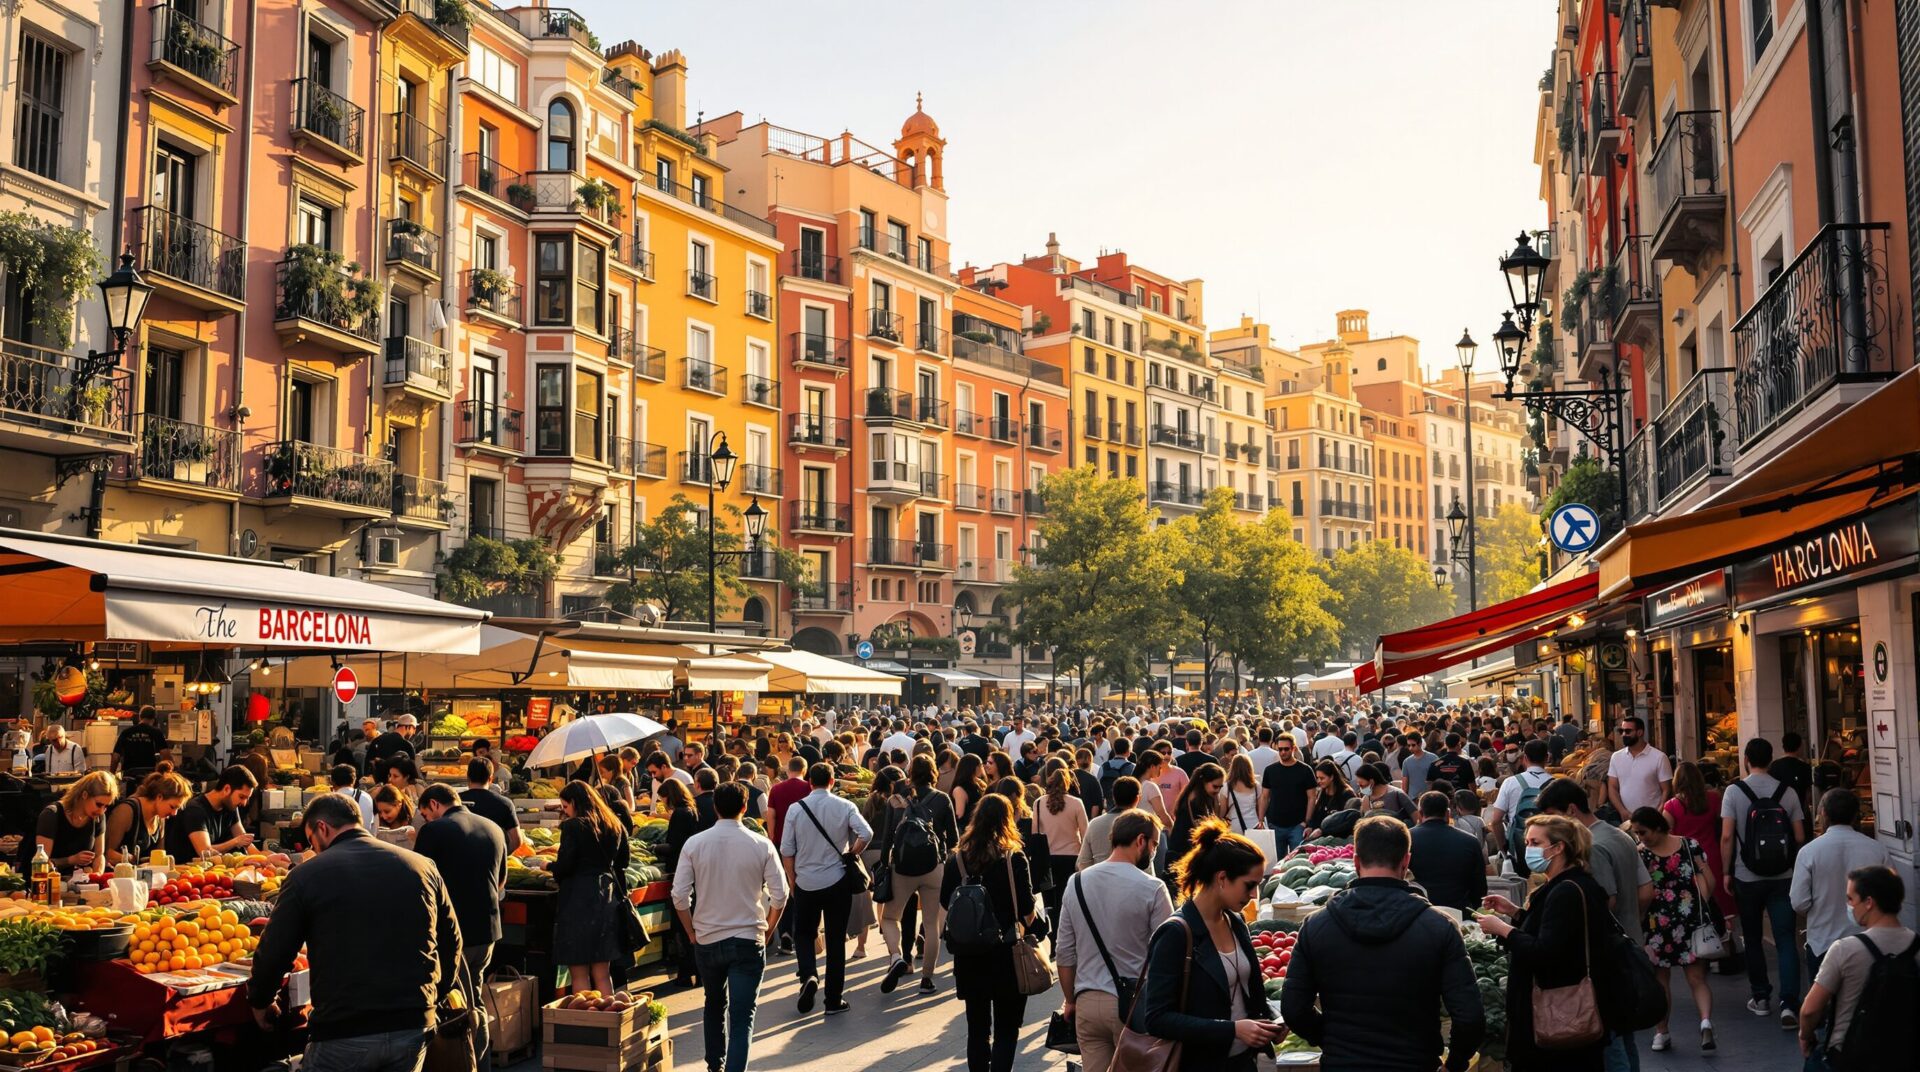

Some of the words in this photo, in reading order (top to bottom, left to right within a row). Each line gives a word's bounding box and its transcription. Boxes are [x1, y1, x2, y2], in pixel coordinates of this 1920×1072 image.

[1773, 521, 1877, 588] HARCZONIA
[196, 603, 237, 638] The
[259, 608, 371, 644] BARCELONA
